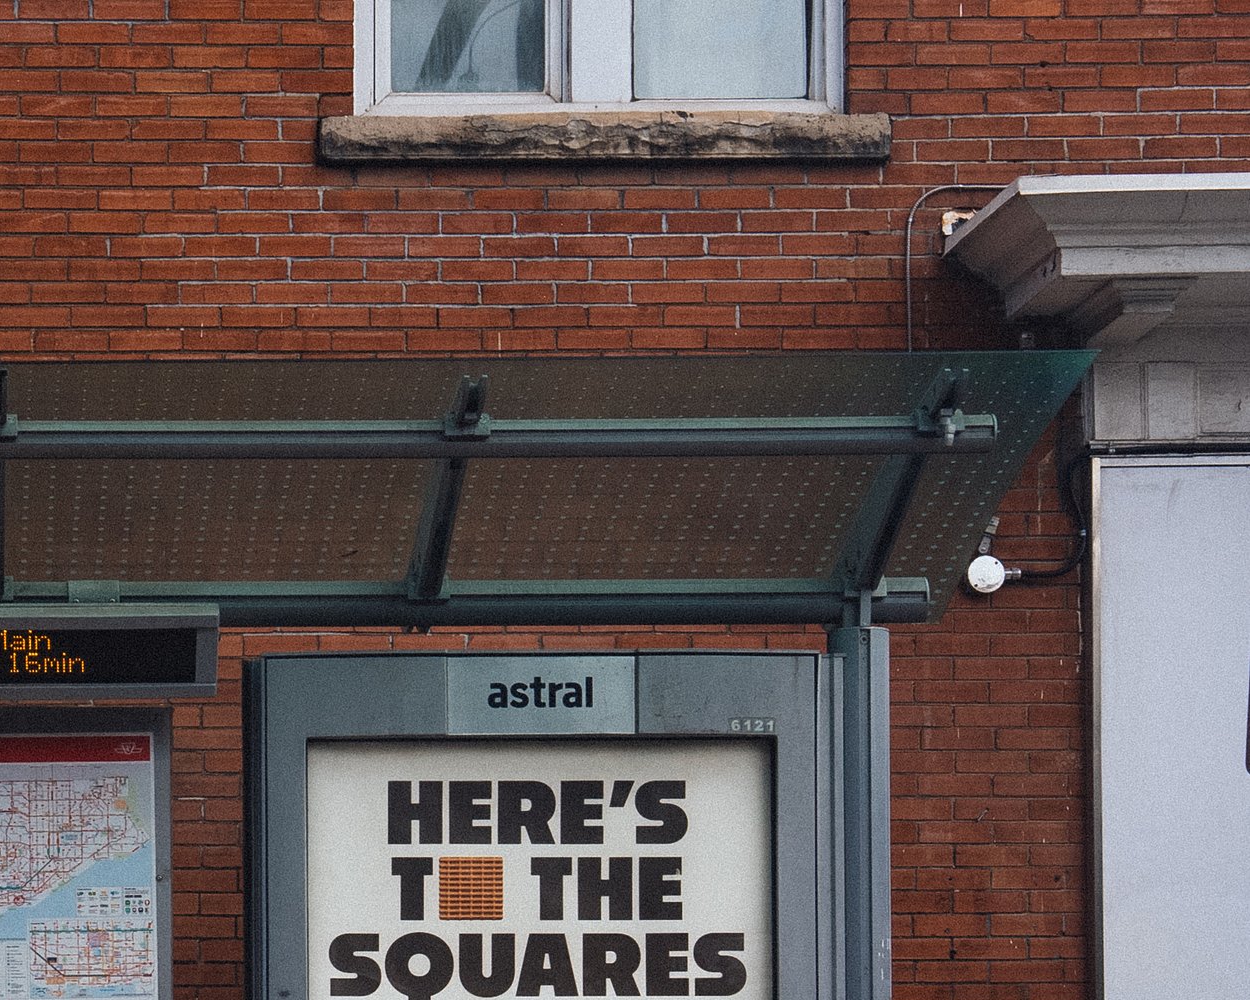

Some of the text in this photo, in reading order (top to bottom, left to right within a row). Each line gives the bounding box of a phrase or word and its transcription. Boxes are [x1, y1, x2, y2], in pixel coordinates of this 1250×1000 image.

[9, 652, 85, 674] 16min
[488, 676, 593, 709] astral
[731, 719, 775, 732] 6121
[387, 780, 688, 845] HERE'S
[530, 856, 682, 921] THE
